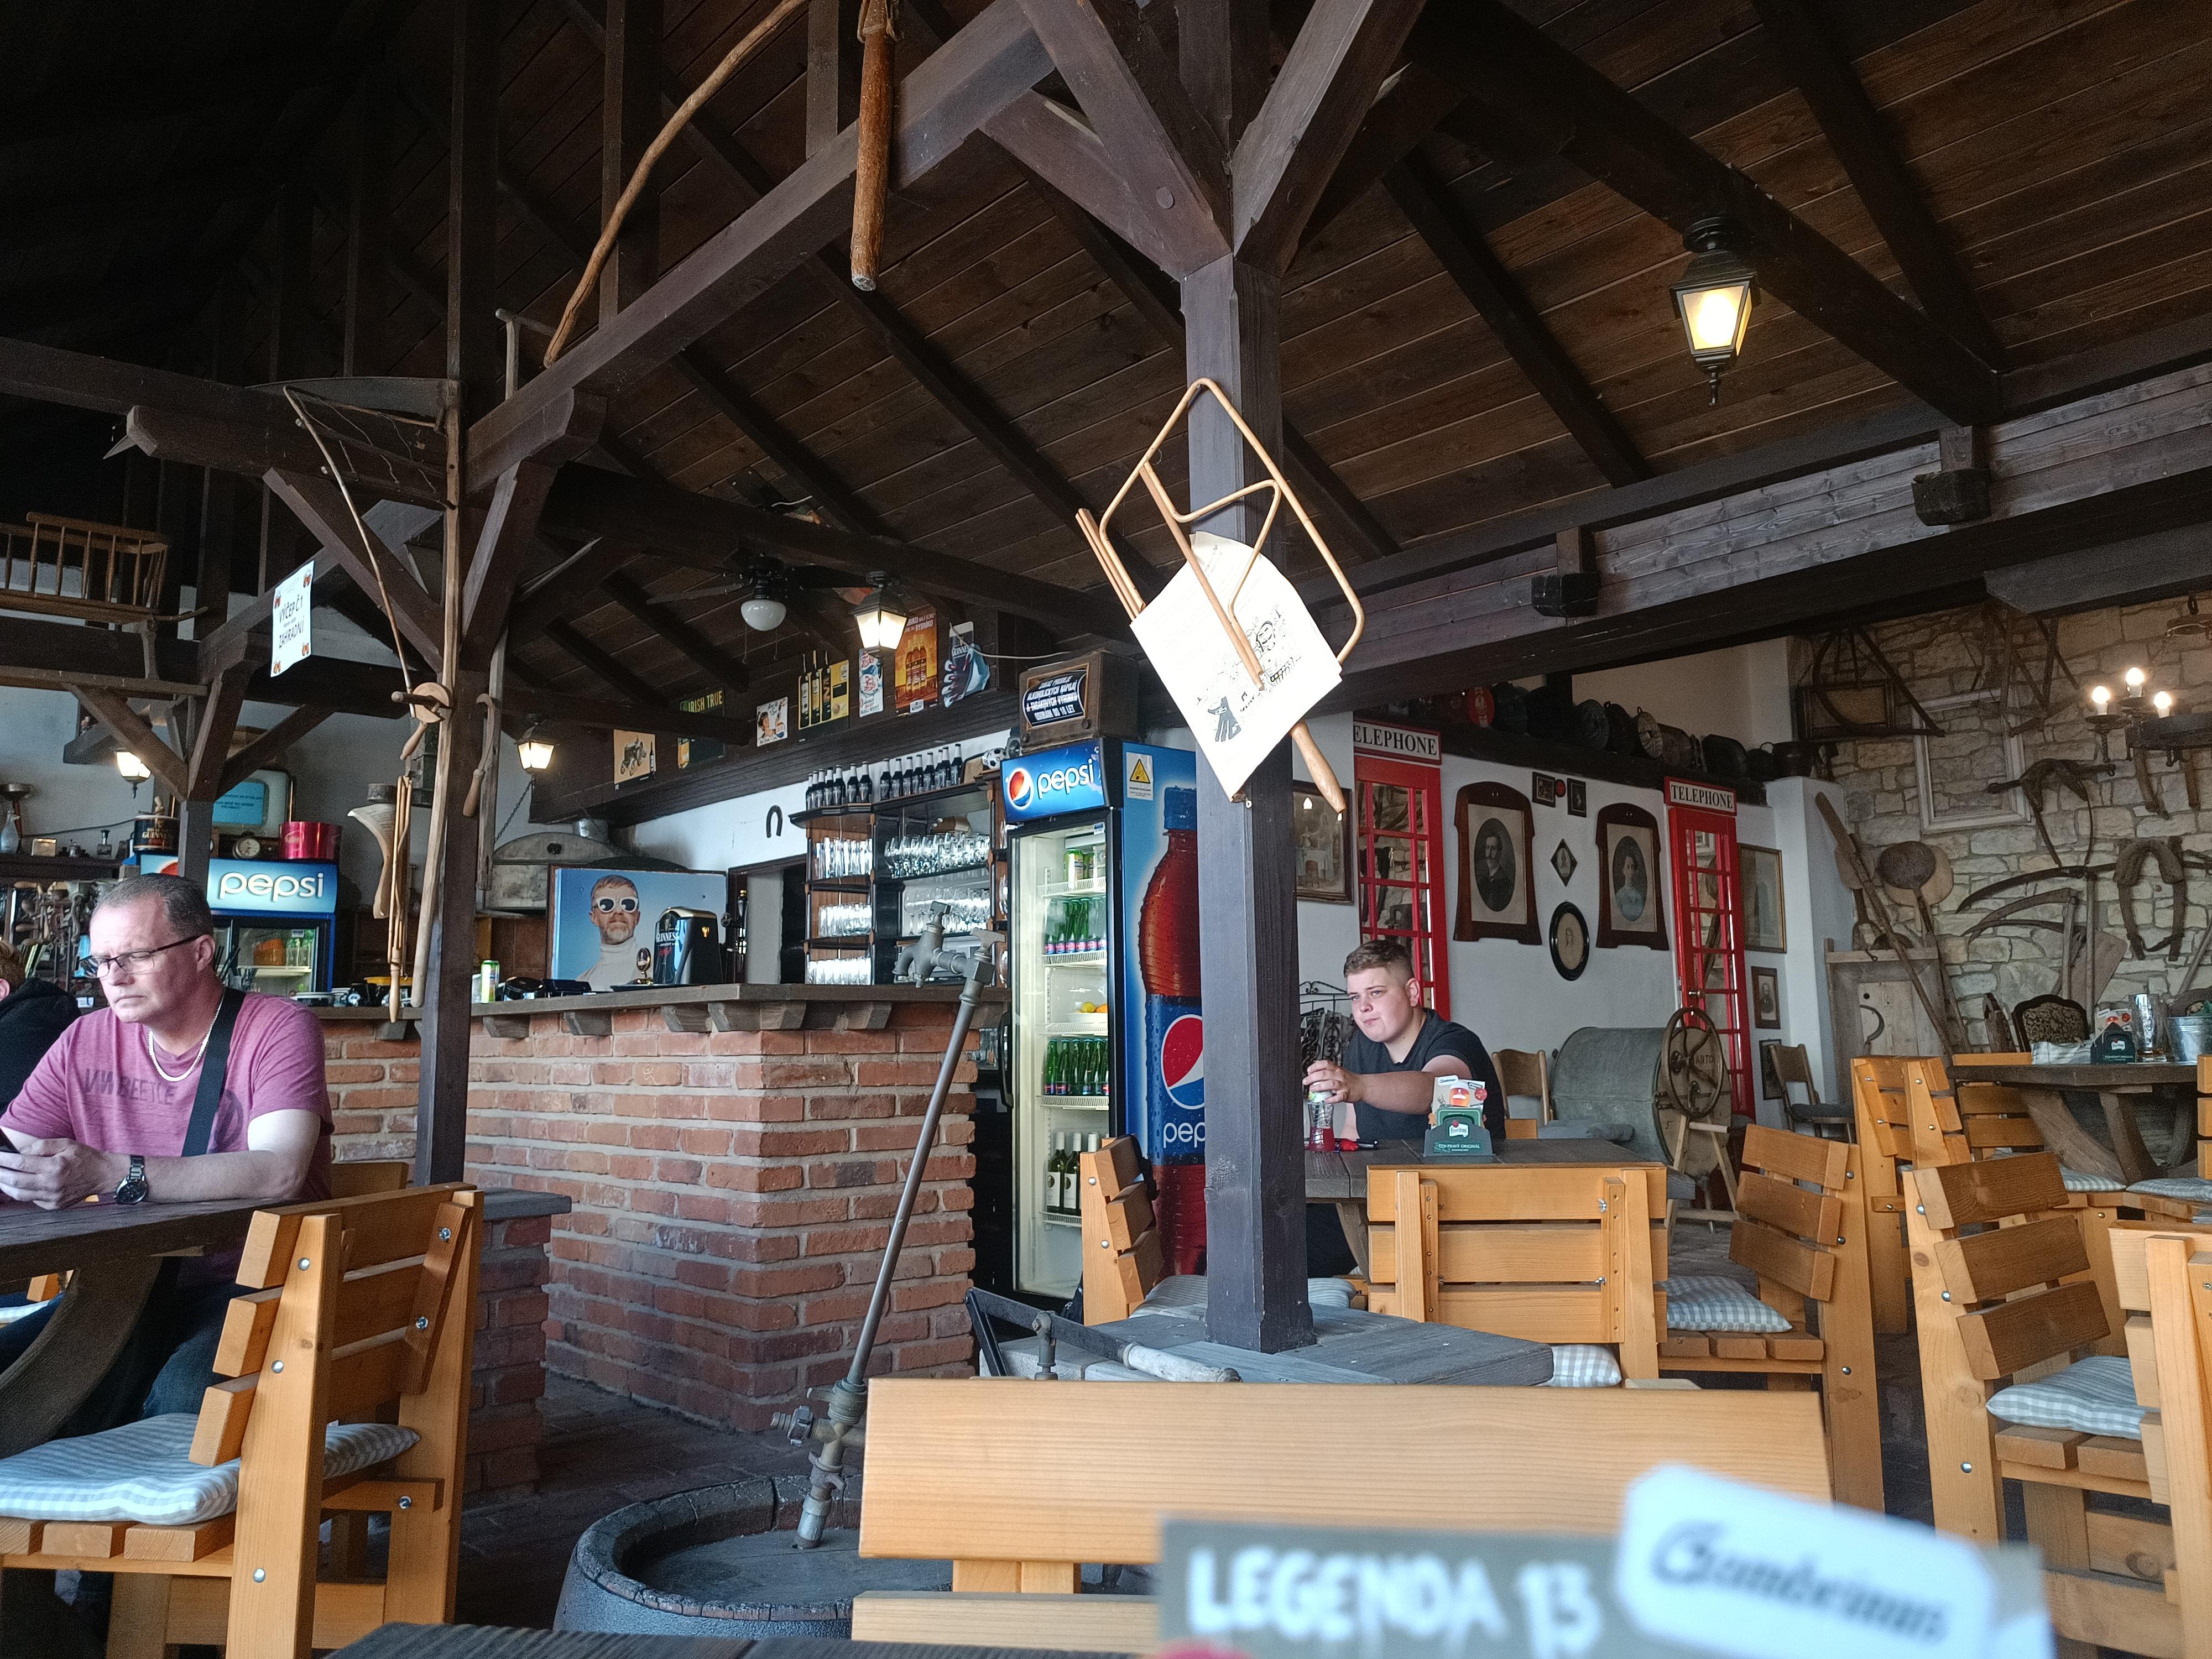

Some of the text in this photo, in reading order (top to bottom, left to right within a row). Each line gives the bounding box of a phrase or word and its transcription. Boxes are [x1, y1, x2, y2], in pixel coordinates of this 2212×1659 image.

[279, 614, 305, 649] ZAHRADNÍ
[688, 690, 723, 713] IRISH TRUE
[1354, 725, 1437, 755] ELEPHONE
[1037, 759, 1094, 800] pepsi
[1671, 785, 1733, 809] TELEPHONE
[220, 872, 324, 902] pepsi
[656, 932, 680, 943] GUINNESS
[117, 1076, 178, 1105] BEETLE
[1164, 1122, 1205, 1149] pep
[1188, 1547, 1508, 1641] LEGENDA
